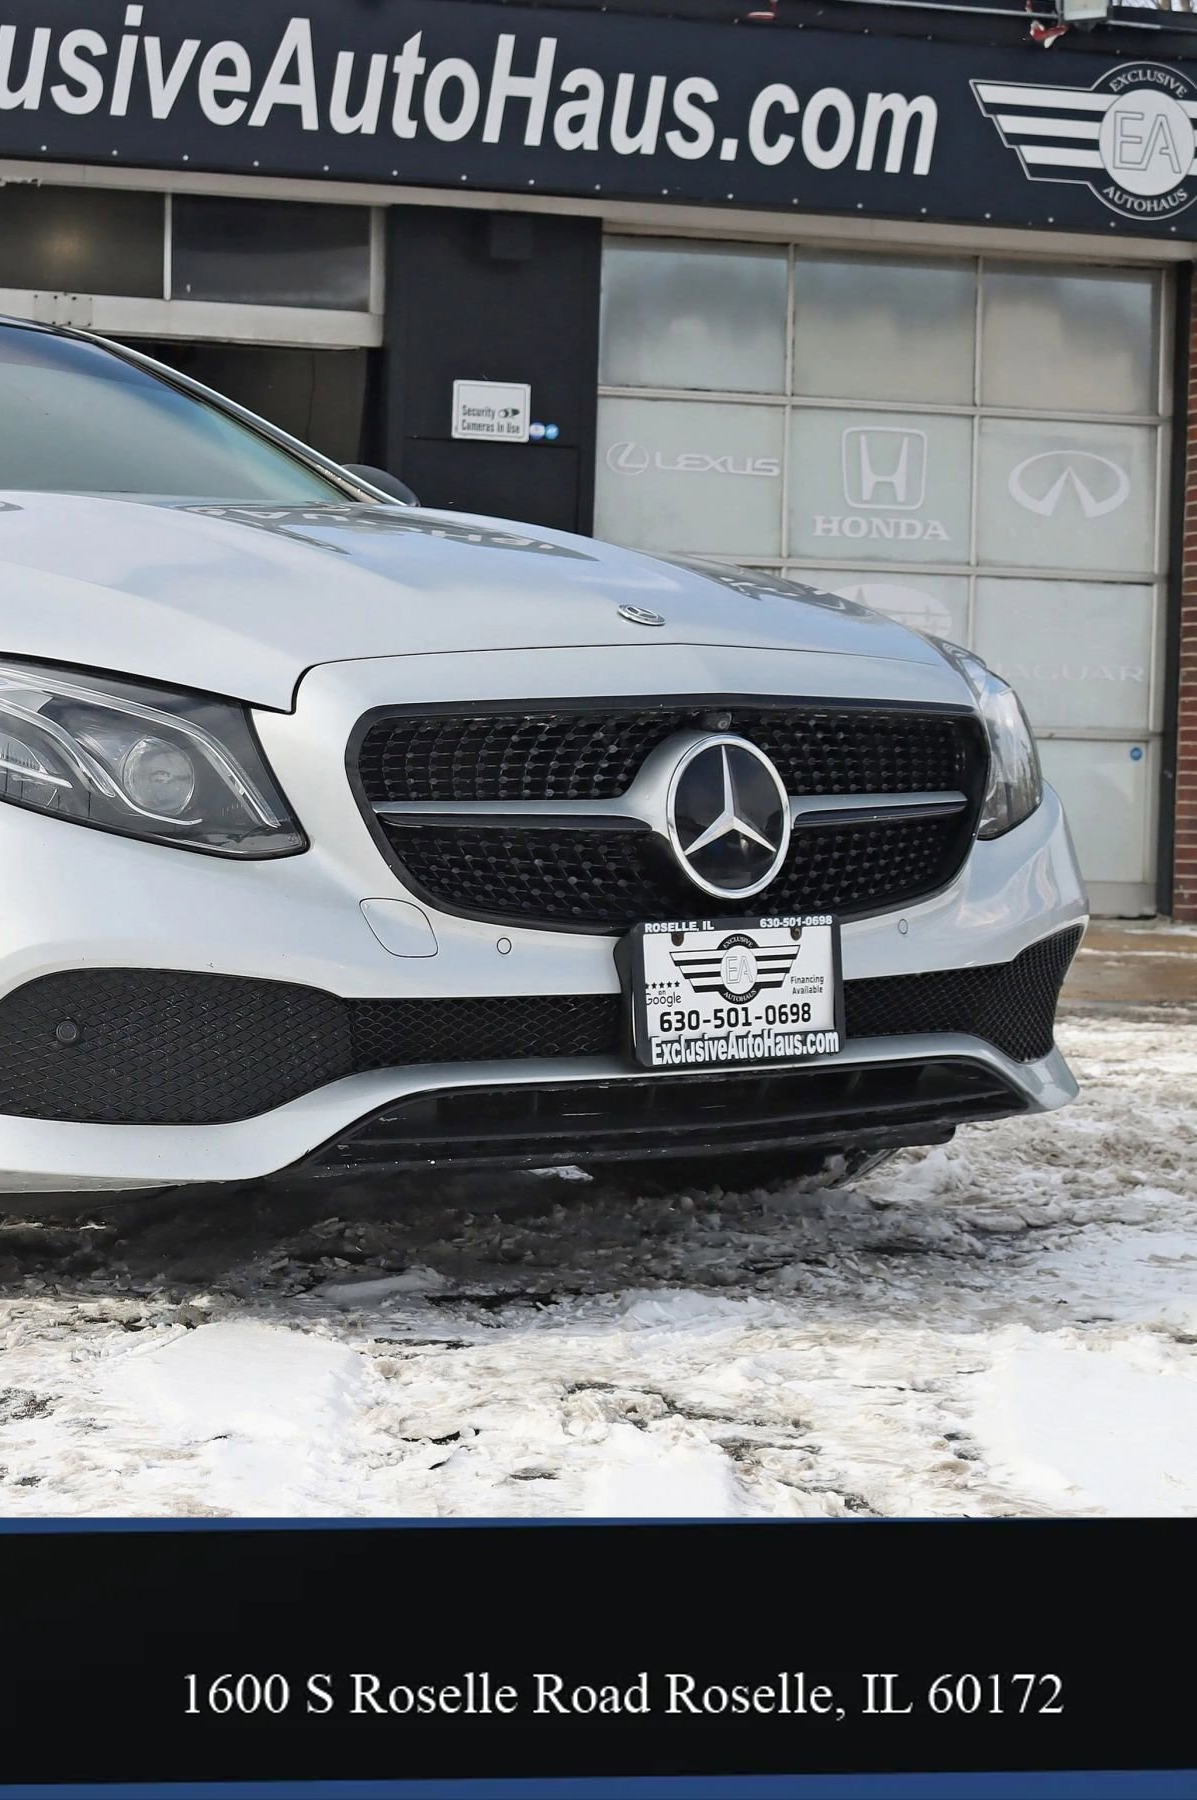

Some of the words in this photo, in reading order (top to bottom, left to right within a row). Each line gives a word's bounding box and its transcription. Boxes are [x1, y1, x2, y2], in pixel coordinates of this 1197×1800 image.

[1109, 69, 1188, 98] EXCLUSIVE
[1113, 111, 1182, 174] EA
[1102, 186, 1188, 212] AUTOHAUS
[462, 404, 496, 420] Security
[462, 419, 495, 433] Cameras
[506, 422, 520, 434] Use
[655, 451, 780, 477] LEXUS
[813, 516, 951, 541] HONDA
[645, 921, 699, 933] ROSELLE,
[703, 920, 715, 931] IL
[760, 915, 833, 928] 630-501-0698
[723, 936, 754, 948] EXCLUSIVE
[790, 975, 824, 985] Financing
[723, 989, 757, 1002] AUTOHAUS
[792, 985, 823, 995] Available
[645, 991, 682, 1007] Google
[659, 1003, 812, 1032] 630-501-0698
[652, 1030, 839, 1065] ExclusiveAutoHaus.com
